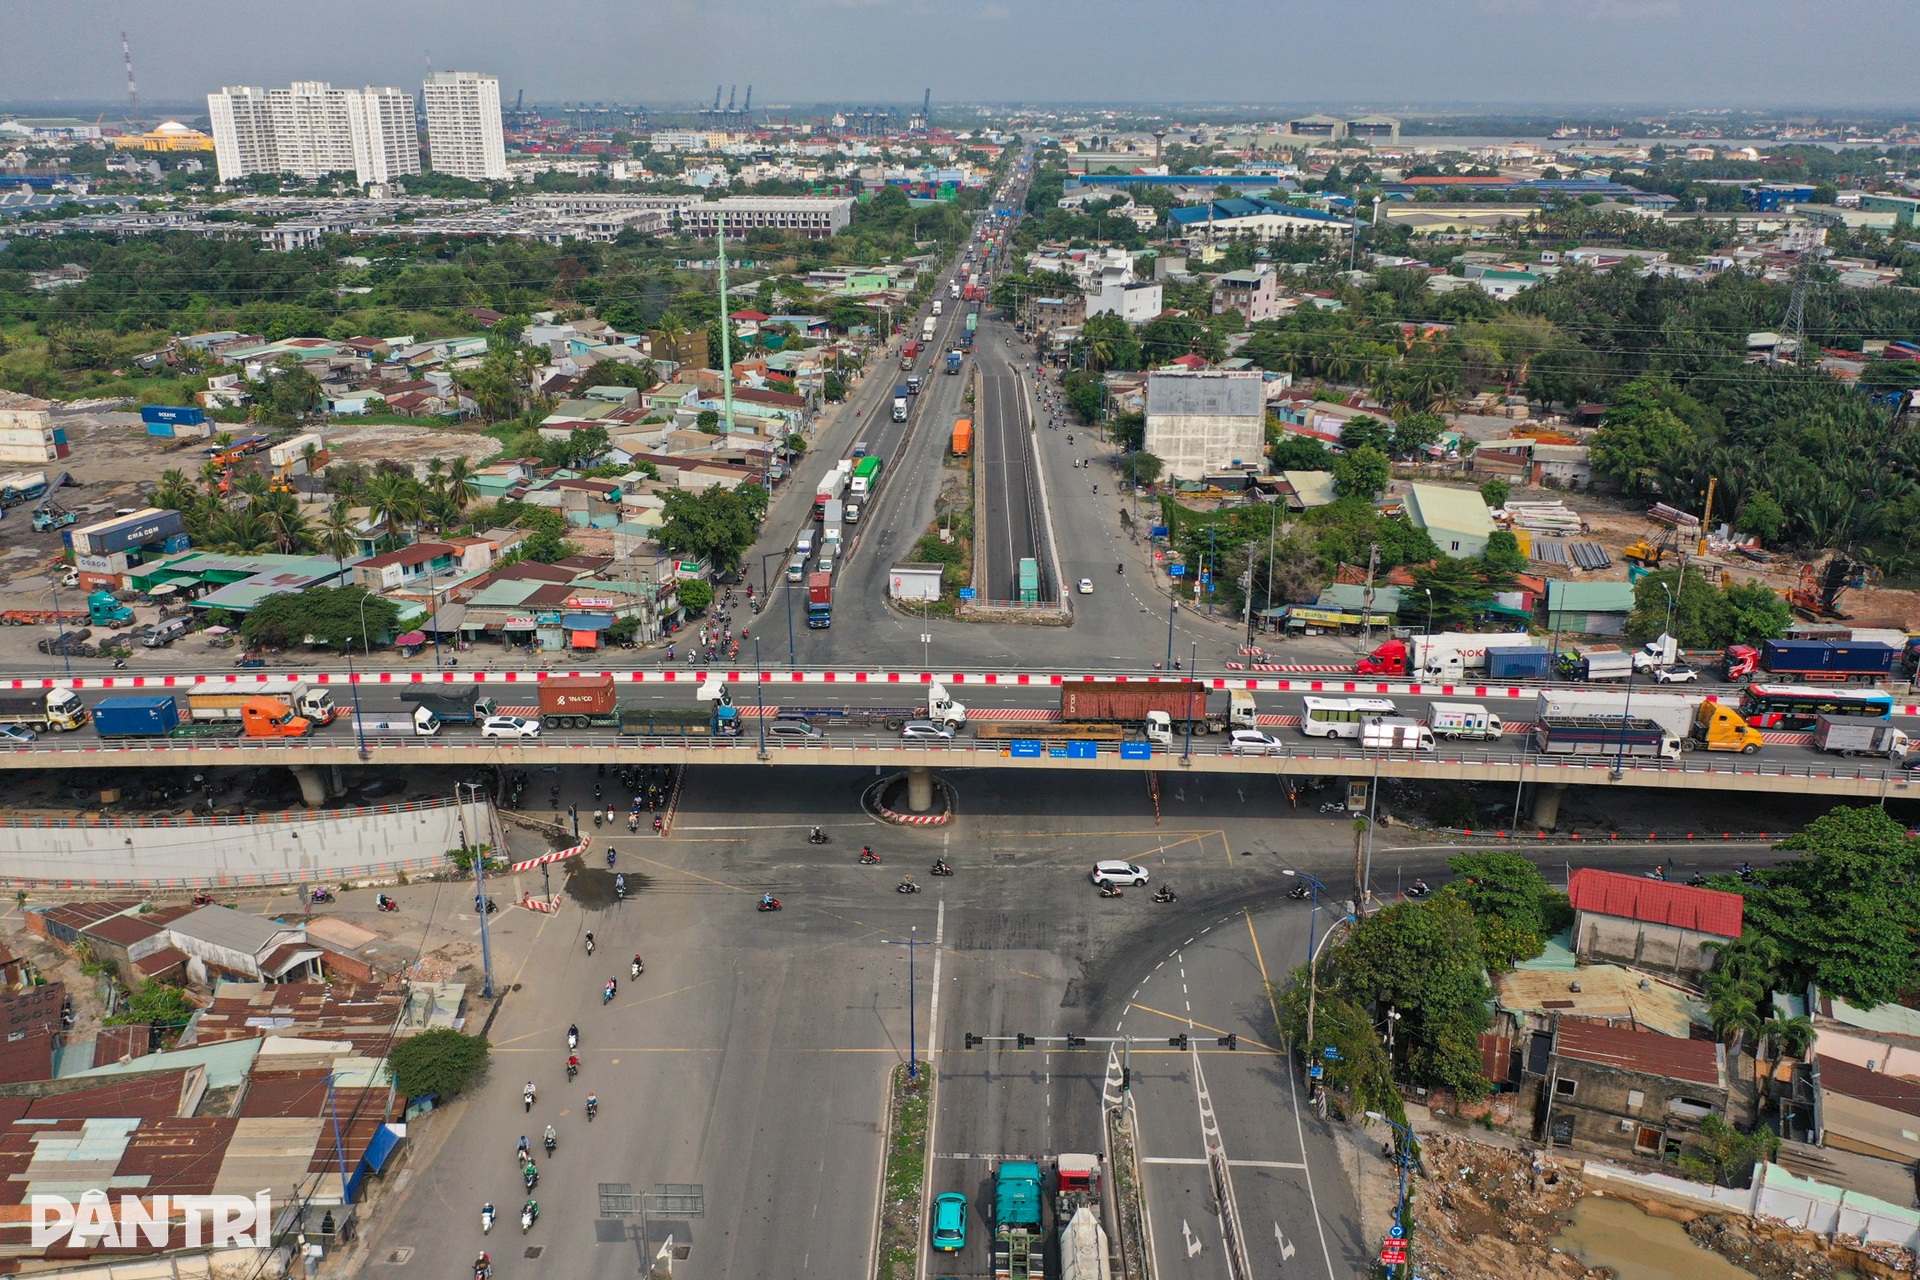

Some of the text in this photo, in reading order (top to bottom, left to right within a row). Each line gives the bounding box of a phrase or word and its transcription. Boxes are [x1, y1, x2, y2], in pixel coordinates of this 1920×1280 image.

[127, 526, 159, 541] CMA CGM
[81, 559, 107, 567] COSCO
